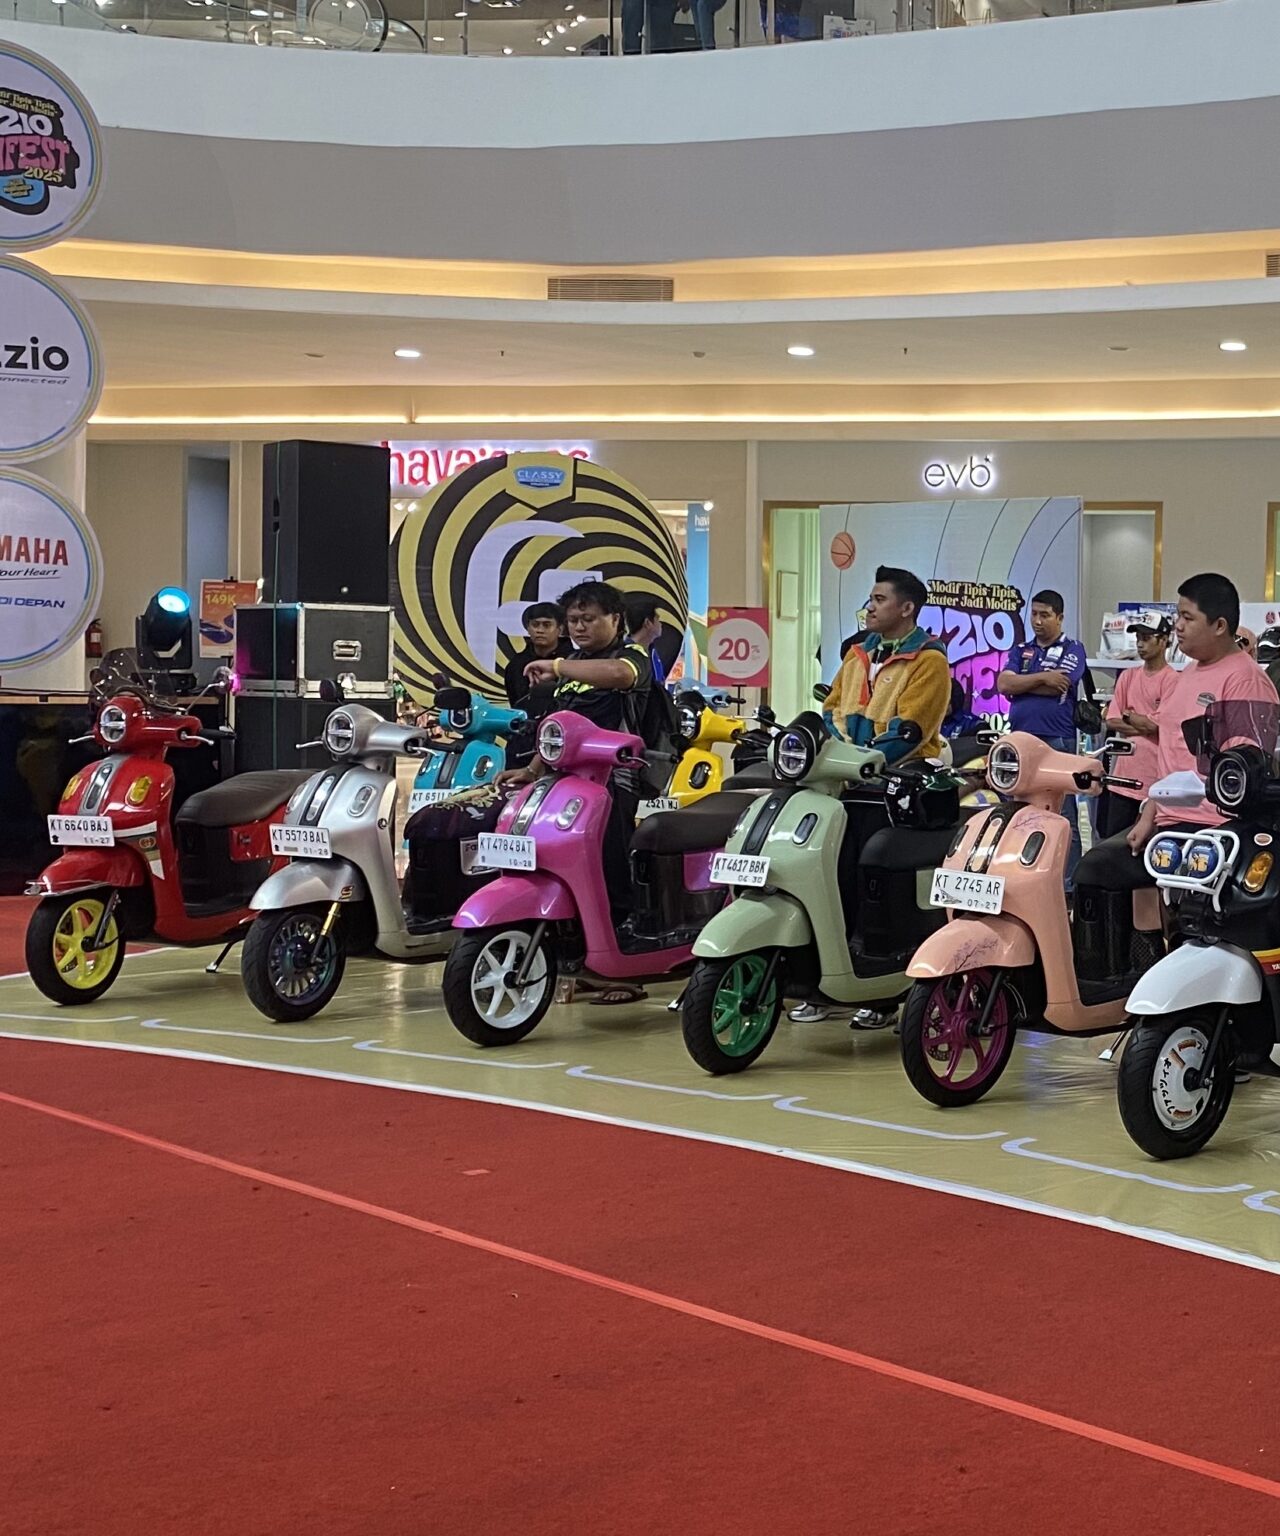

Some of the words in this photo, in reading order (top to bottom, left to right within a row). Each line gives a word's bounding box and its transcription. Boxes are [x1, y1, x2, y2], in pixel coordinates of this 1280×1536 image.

[24, 166, 63, 183] 2025
[0, 336, 69, 372] zio
[517, 470, 563, 479] CLASSY
[925, 456, 991, 488] evb
[23, 567, 59, 577] Heart
[14, 597, 66, 608] DEPAN
[204, 594, 236, 605] 149K
[960, 595, 984, 609] Jadi
[50, 819, 62, 831] KT
[64, 820, 89, 831] 6640
[90, 821, 108, 832] BAJ
[272, 828, 283, 841] KT
[285, 829, 308, 842] 5573
[309, 831, 328, 844] BAL
[935, 874, 949, 888] KT
[955, 876, 983, 893] 2745
[986, 881, 1001, 896] AR
